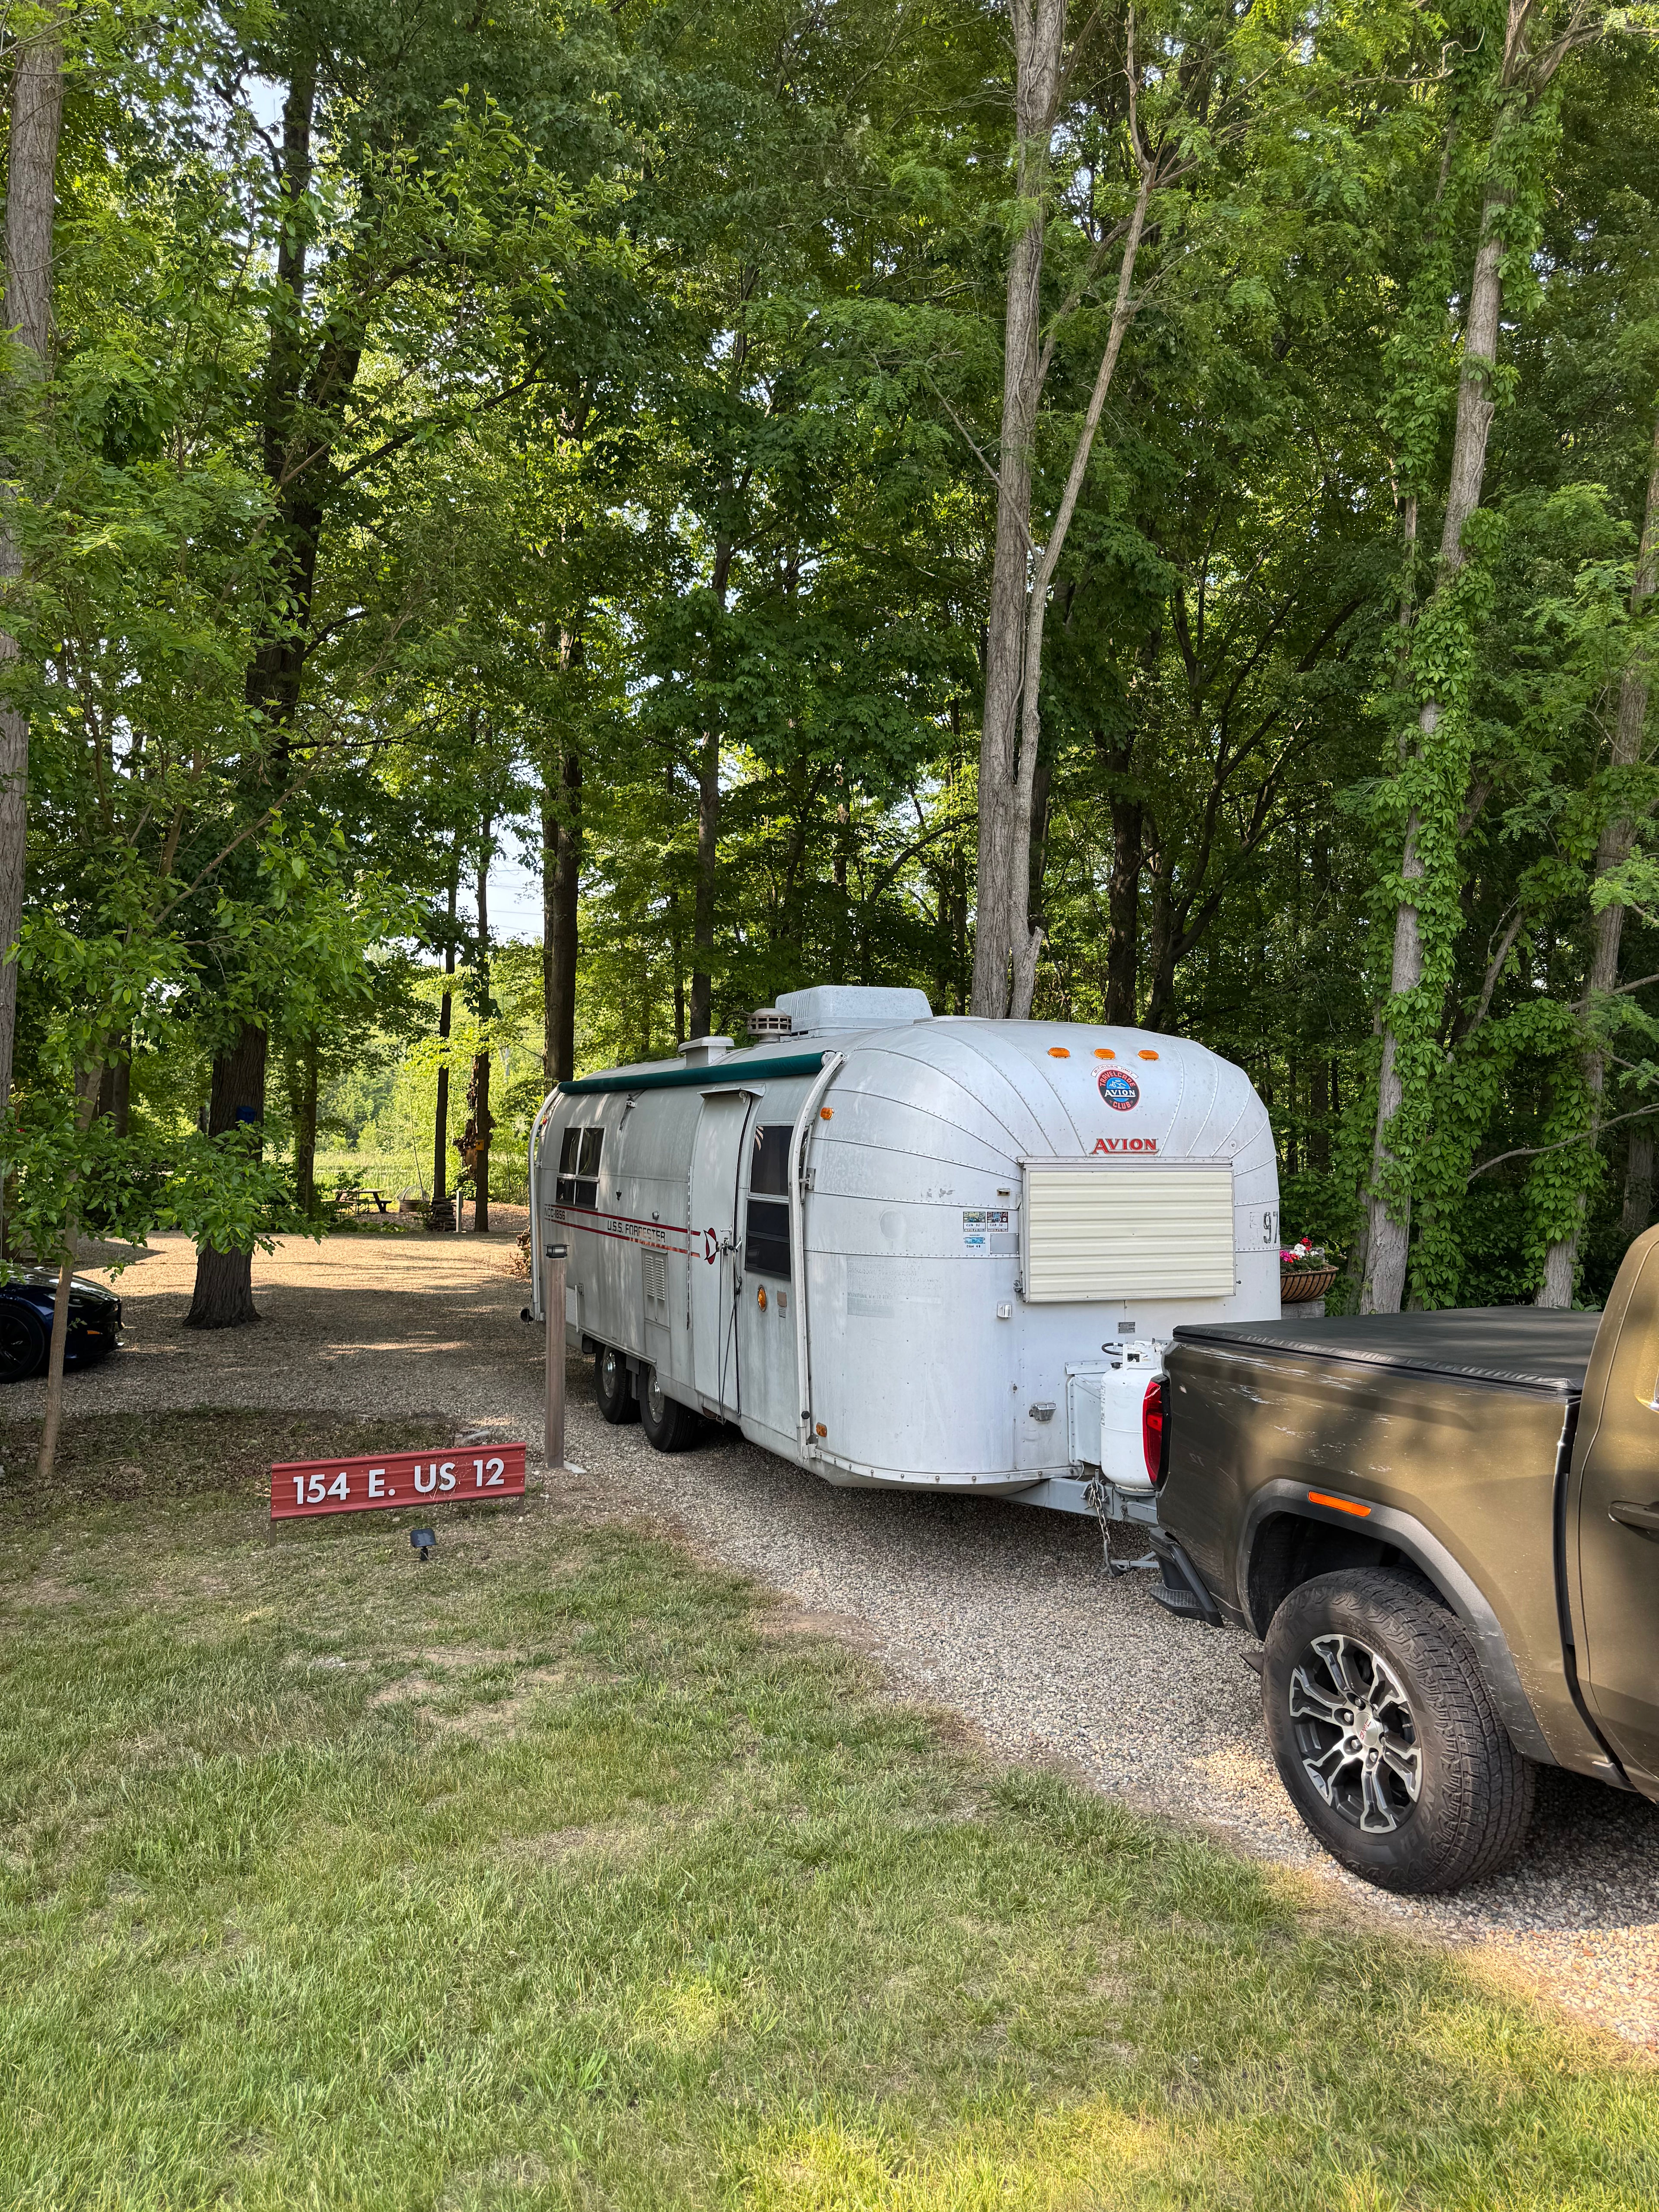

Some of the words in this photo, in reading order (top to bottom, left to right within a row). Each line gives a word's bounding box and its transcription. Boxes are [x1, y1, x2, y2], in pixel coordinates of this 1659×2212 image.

[1100, 1071, 1136, 1087] TRAVELCADE
[1104, 1089, 1136, 1097] AVION
[1112, 1101, 1131, 1109] CLUB
[1089, 1138, 1159, 1154] AVION
[607, 1220, 623, 1233] U.S.S.
[626, 1224, 665, 1243] FORRESTER
[293, 1472, 350, 1504] 154
[369, 1469, 396, 1498] E.
[414, 1462, 456, 1493] US
[473, 1458, 505, 1487] 12
[1360, 1719, 1371, 1740] GMC
